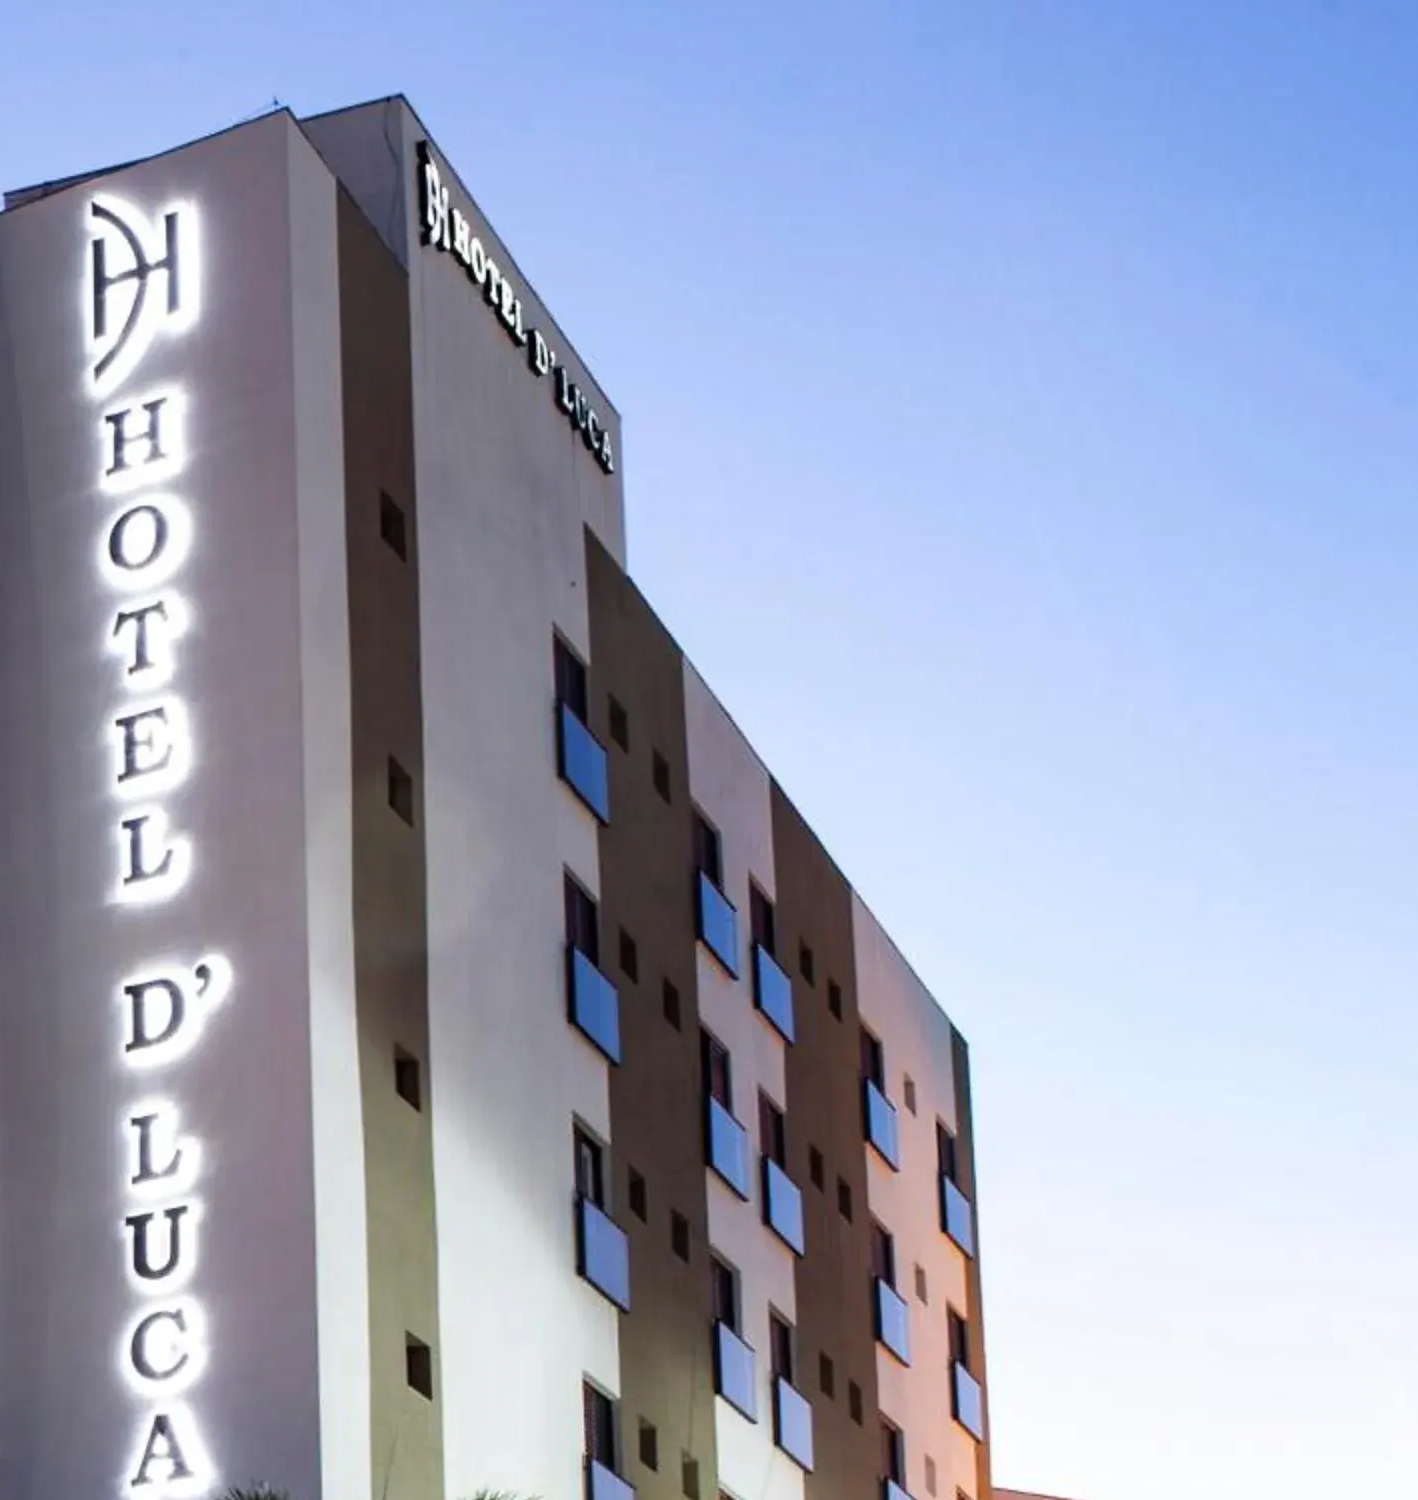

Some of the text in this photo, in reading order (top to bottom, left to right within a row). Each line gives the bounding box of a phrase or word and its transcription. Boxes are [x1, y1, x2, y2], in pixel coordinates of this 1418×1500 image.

[449, 207, 528, 346] HOTEL
[554, 365, 615, 474] LUCA
[103, 397, 174, 883] HOTEL
[125, 1112, 195, 1487] LUCA
